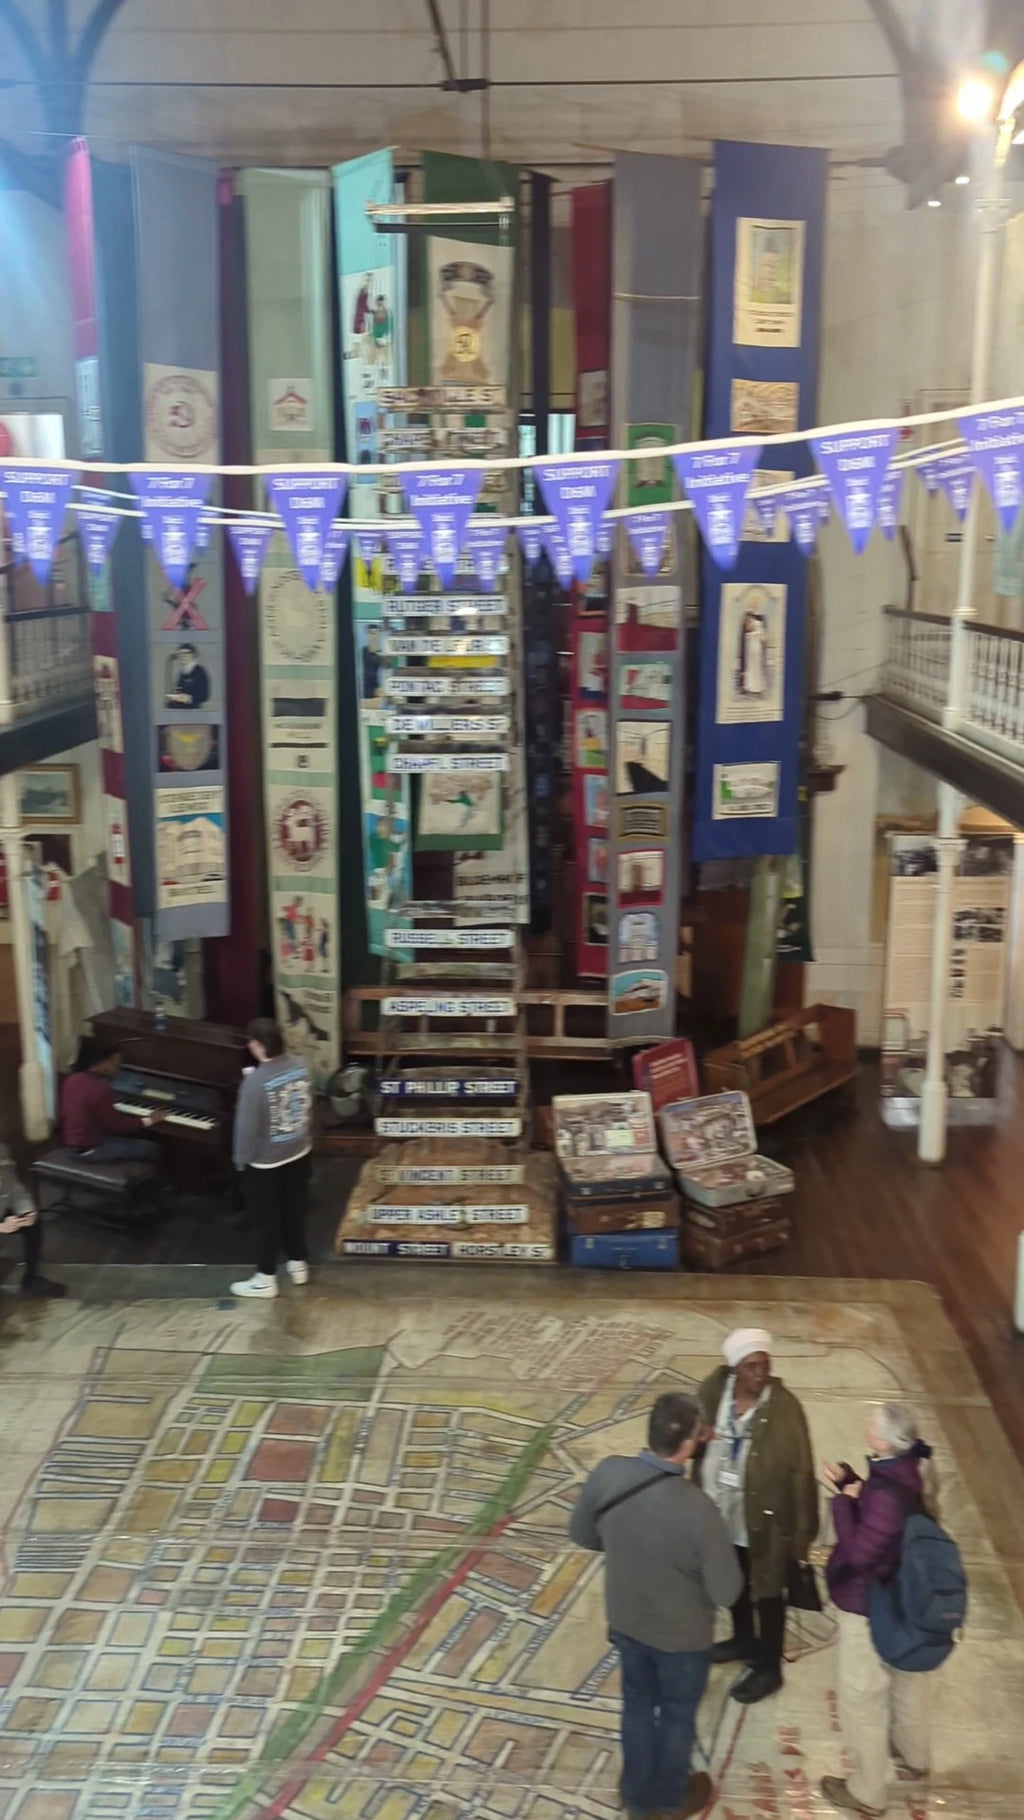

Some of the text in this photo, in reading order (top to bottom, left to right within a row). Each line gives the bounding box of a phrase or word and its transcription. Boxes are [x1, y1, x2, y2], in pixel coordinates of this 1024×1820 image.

[380, 1081, 401, 1094] ST
[463, 1081, 517, 1094] STREET
[461, 1121, 514, 1133] STREET
[460, 1169, 514, 1181] STREET
[418, 1209, 461, 1221] ASHLE
[472, 1209, 524, 1221] STREET
